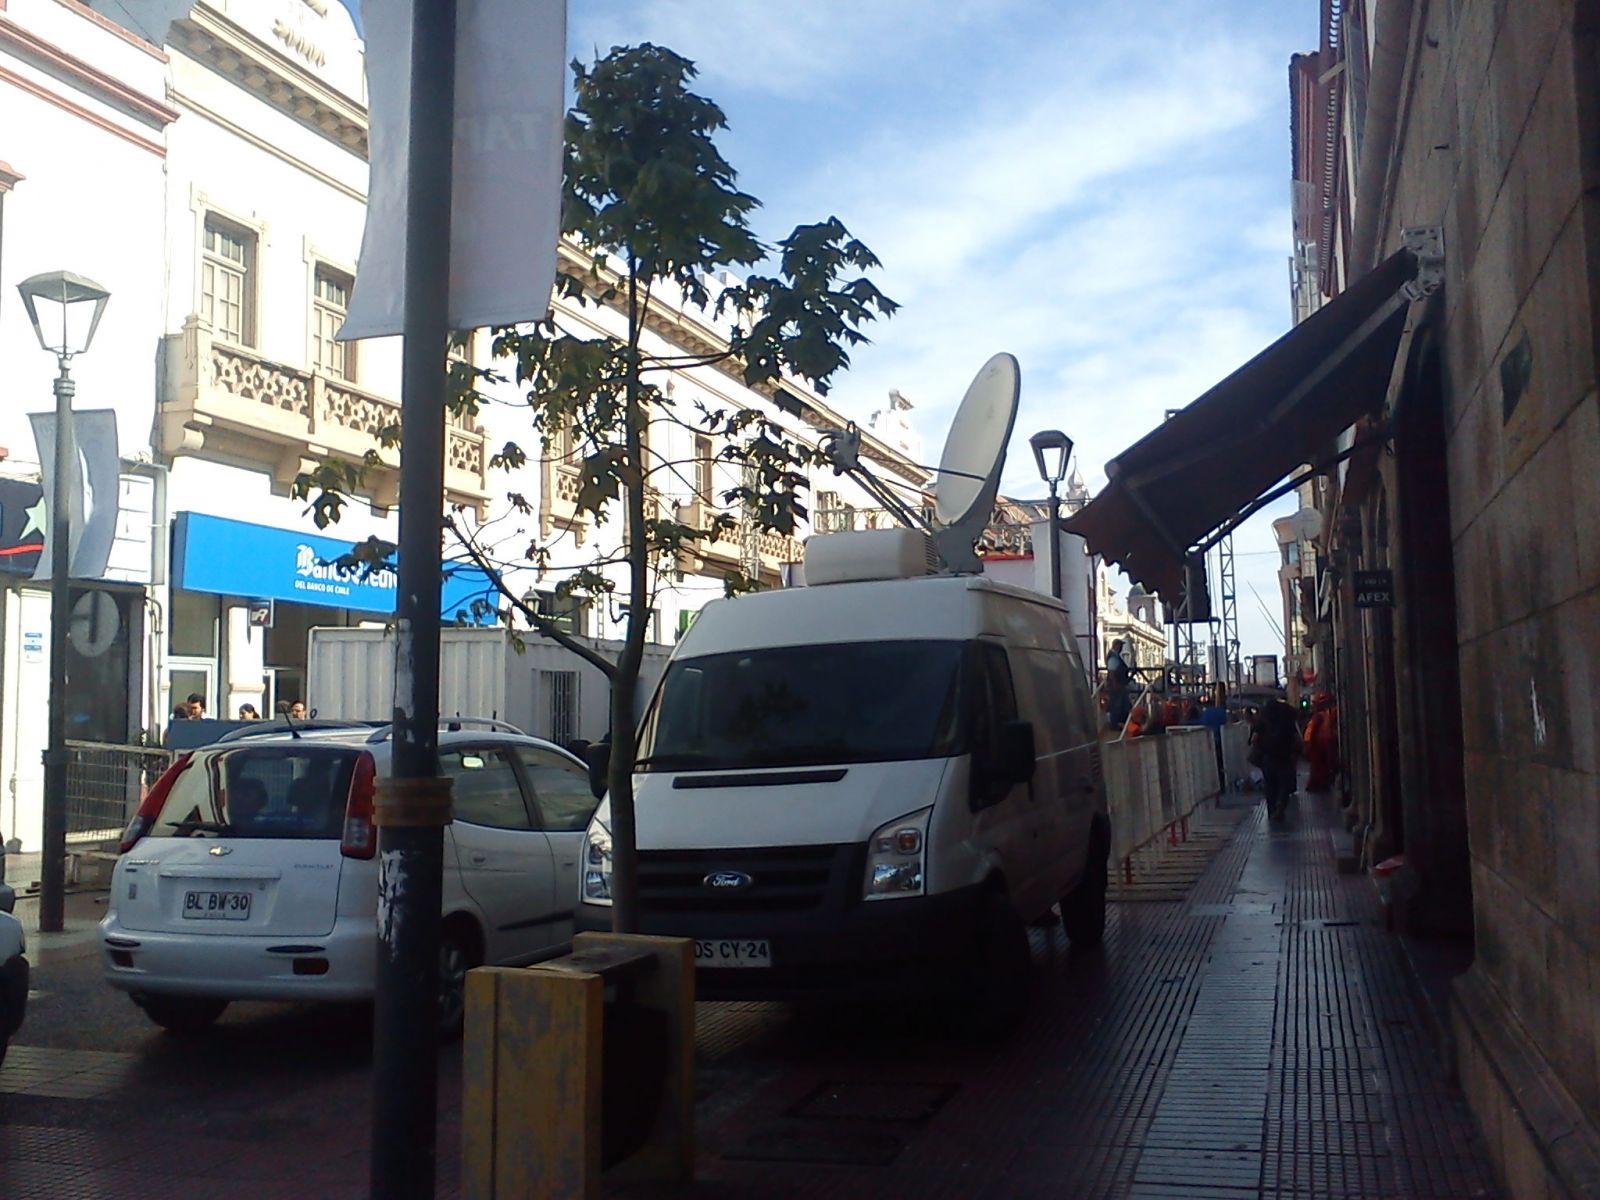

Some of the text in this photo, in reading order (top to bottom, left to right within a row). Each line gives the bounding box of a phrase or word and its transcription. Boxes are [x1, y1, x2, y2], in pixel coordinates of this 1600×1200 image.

[294, 580, 306, 590] DEL
[306, 581, 326, 592] BANCO
[326, 585, 335, 593] DE
[1358, 591, 1390, 602] AFEX
[186, 894, 204, 910] BL
